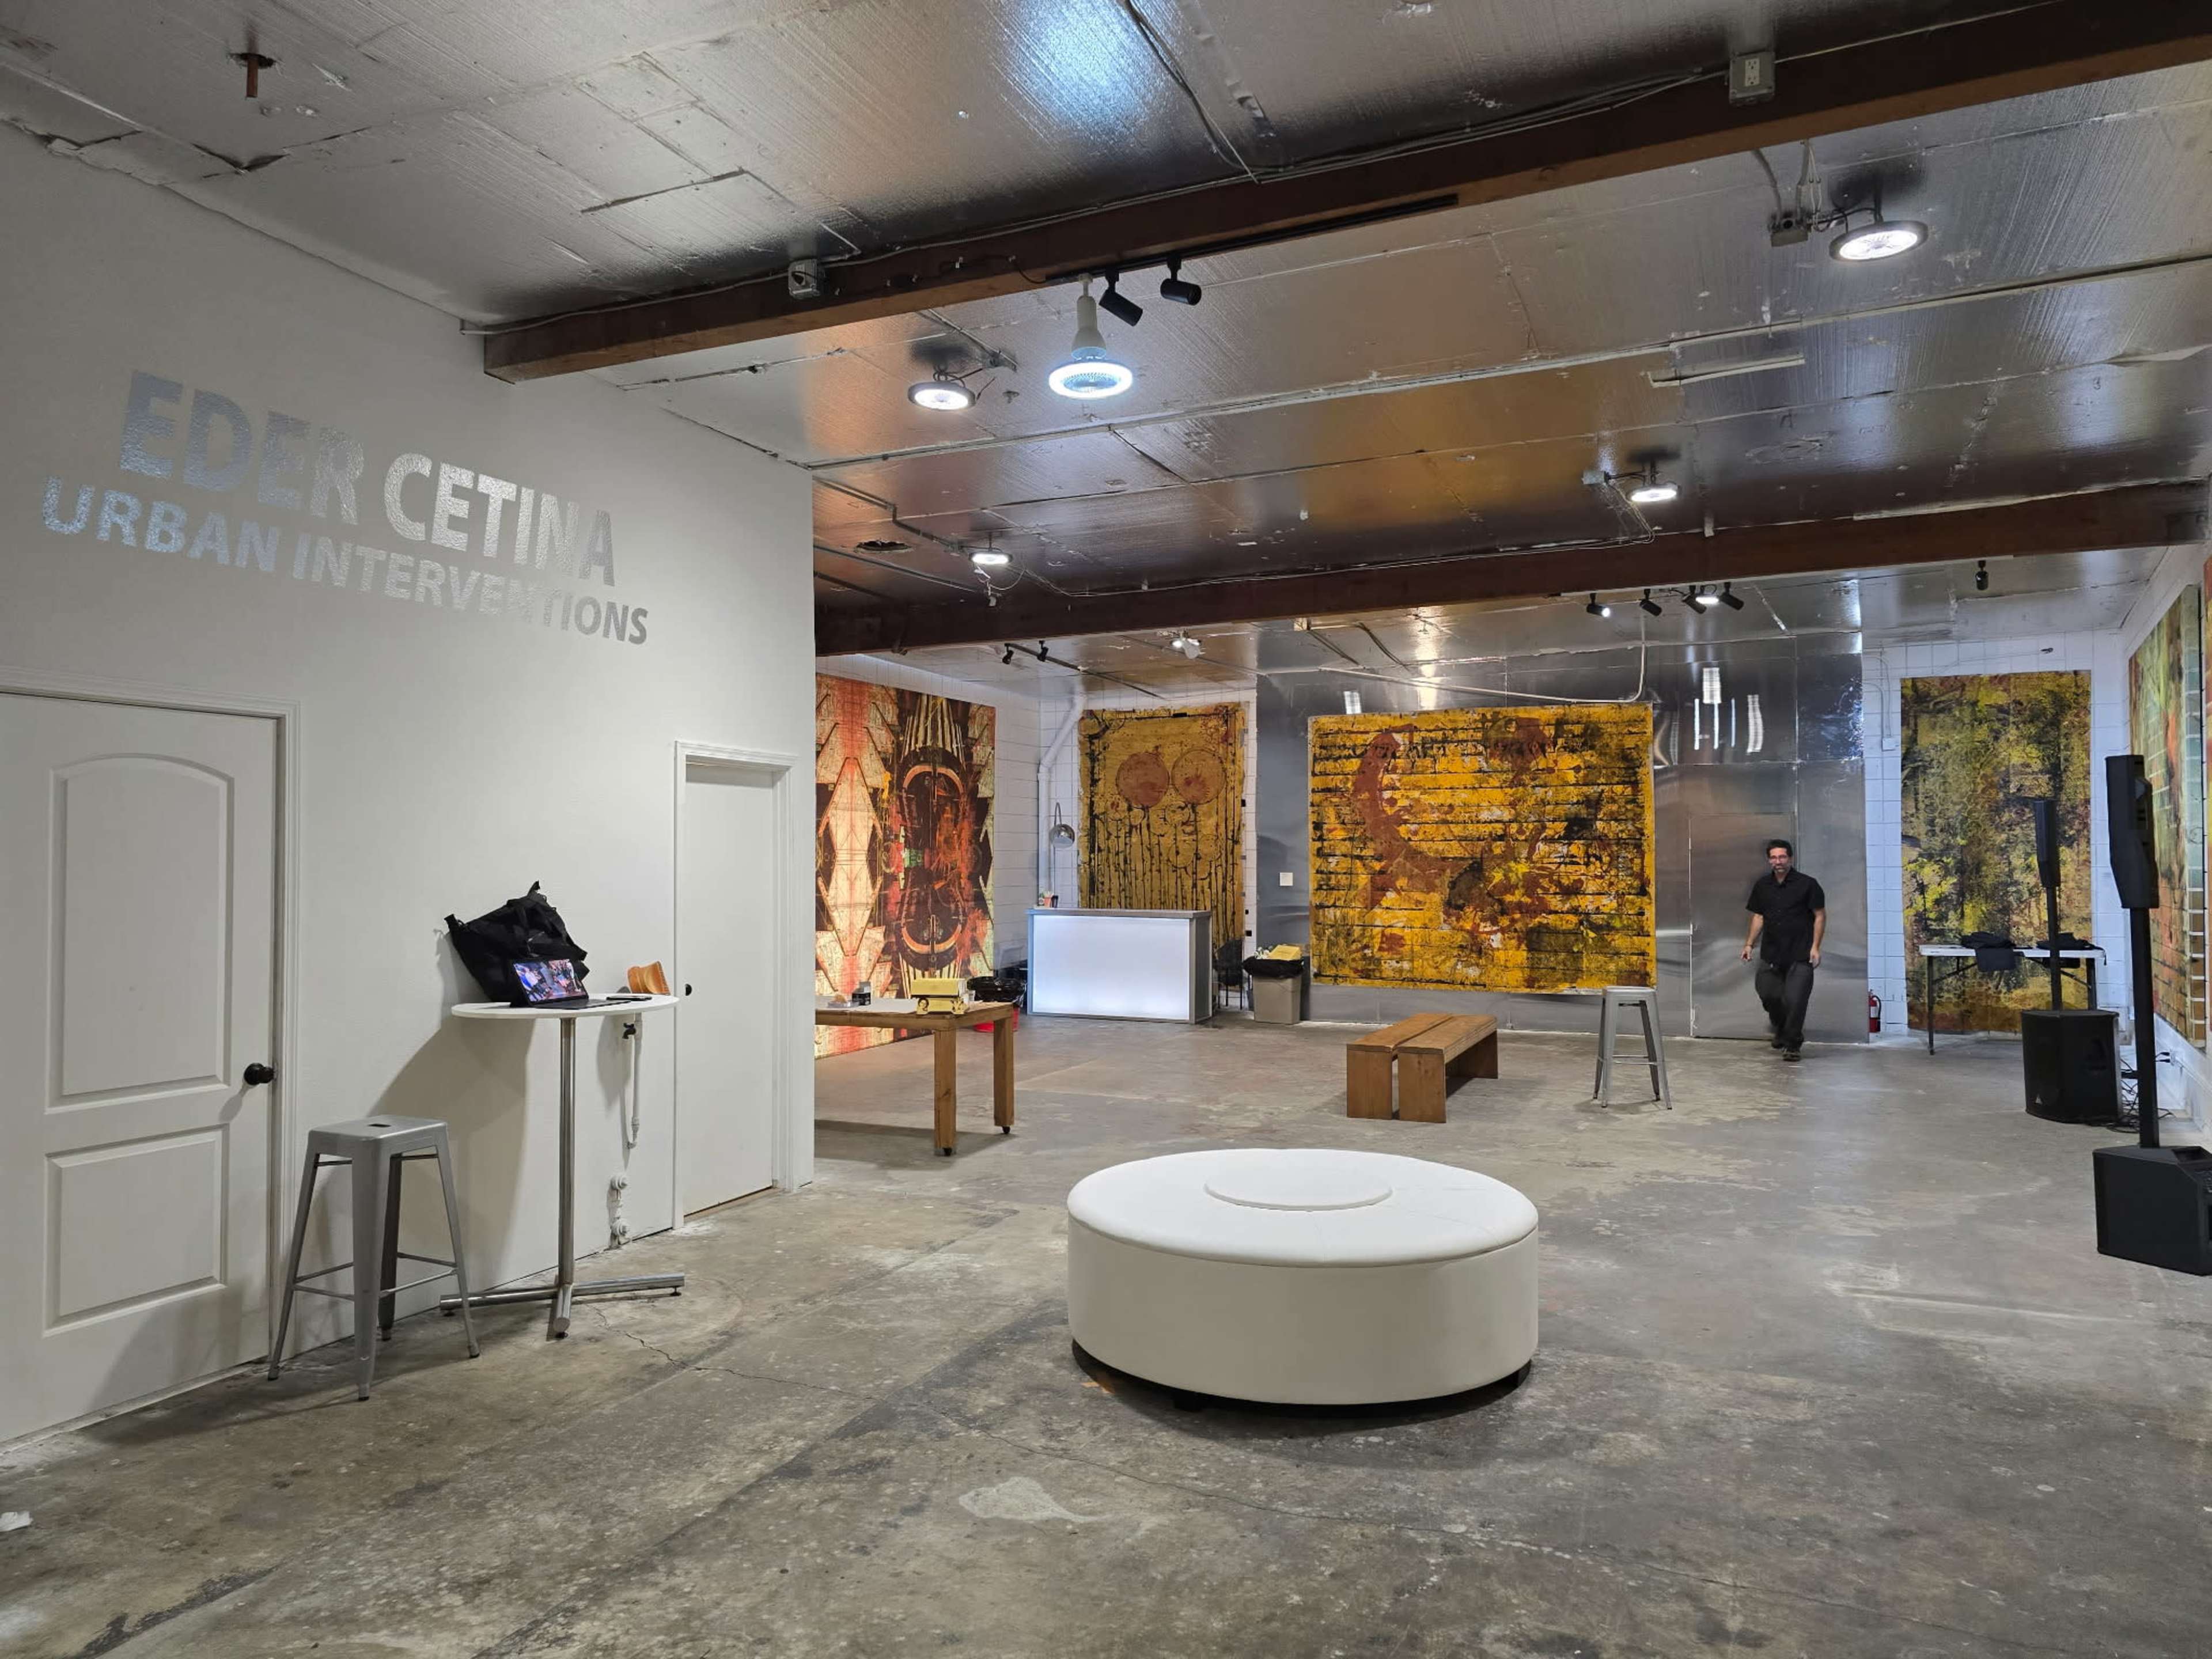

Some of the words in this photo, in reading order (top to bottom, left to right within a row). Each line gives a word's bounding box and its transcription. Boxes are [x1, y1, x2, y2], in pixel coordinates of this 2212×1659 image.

[43, 476, 279, 571] URBAN
[293, 535, 649, 645] INTERVENTIONS
[120, 371, 364, 525] EDER
[384, 453, 615, 587] CETINA
